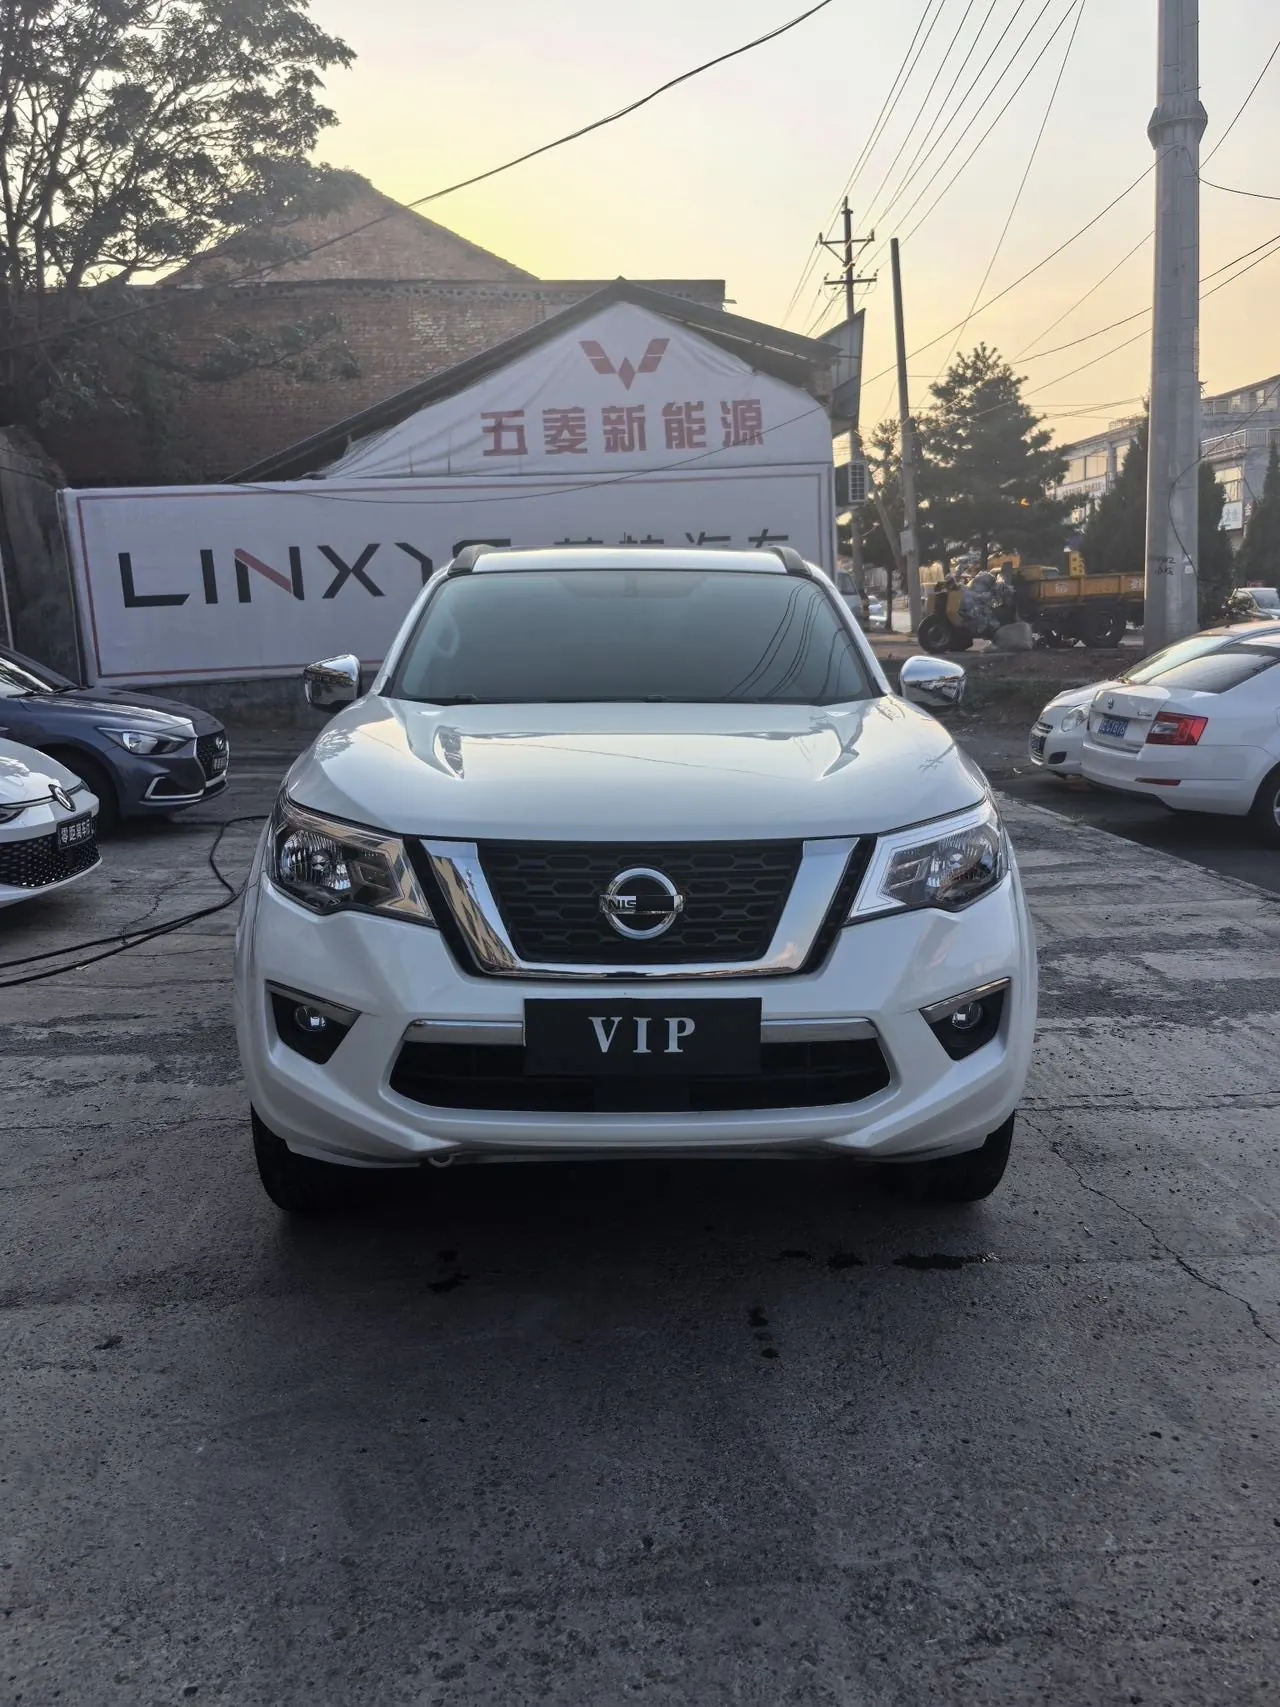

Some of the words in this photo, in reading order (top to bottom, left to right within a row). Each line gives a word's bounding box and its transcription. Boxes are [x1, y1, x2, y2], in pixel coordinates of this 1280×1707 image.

[480, 398, 764, 457] 五菱新能源
[588, 1016, 696, 1053] VIP
